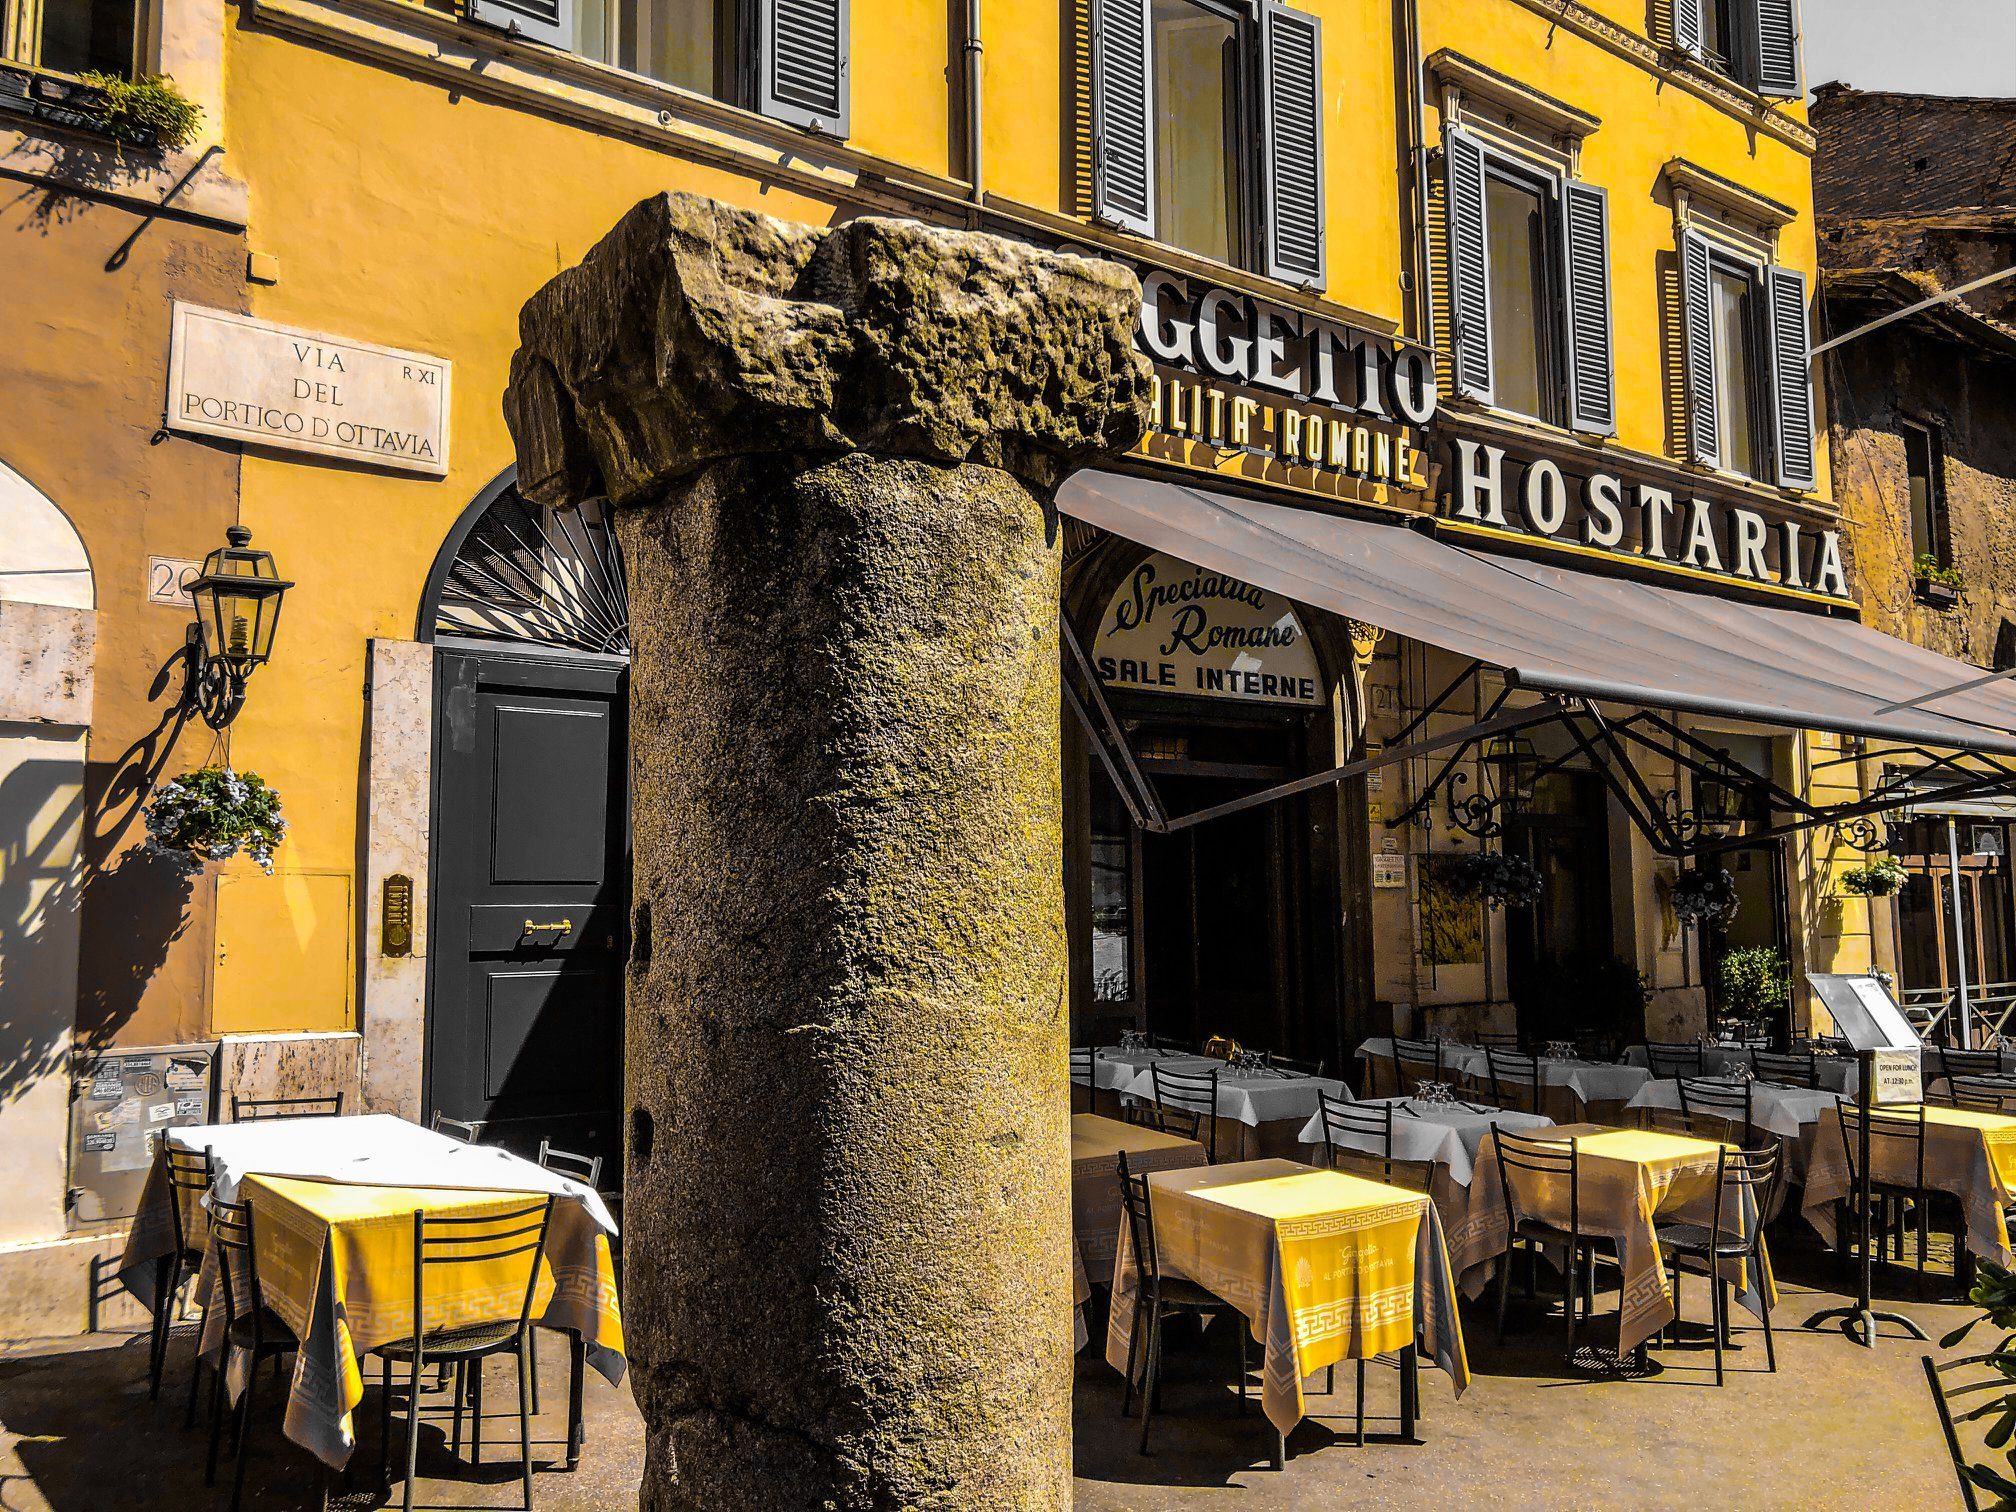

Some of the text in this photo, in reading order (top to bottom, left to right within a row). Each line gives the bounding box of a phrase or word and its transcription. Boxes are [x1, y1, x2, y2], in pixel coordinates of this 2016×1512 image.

[293, 343, 346, 372] VIA
[418, 369, 435, 384] XI
[185, 392, 304, 434] PORTICO
[293, 378, 343, 406] DEL
[1283, 408, 1411, 482] ROMANE
[1449, 438, 1848, 597] HOSTARIA
[1160, 604, 1295, 656] Romane
[1098, 657, 1314, 700] SALE INTERNE
[1375, 688, 1392, 709] 21
